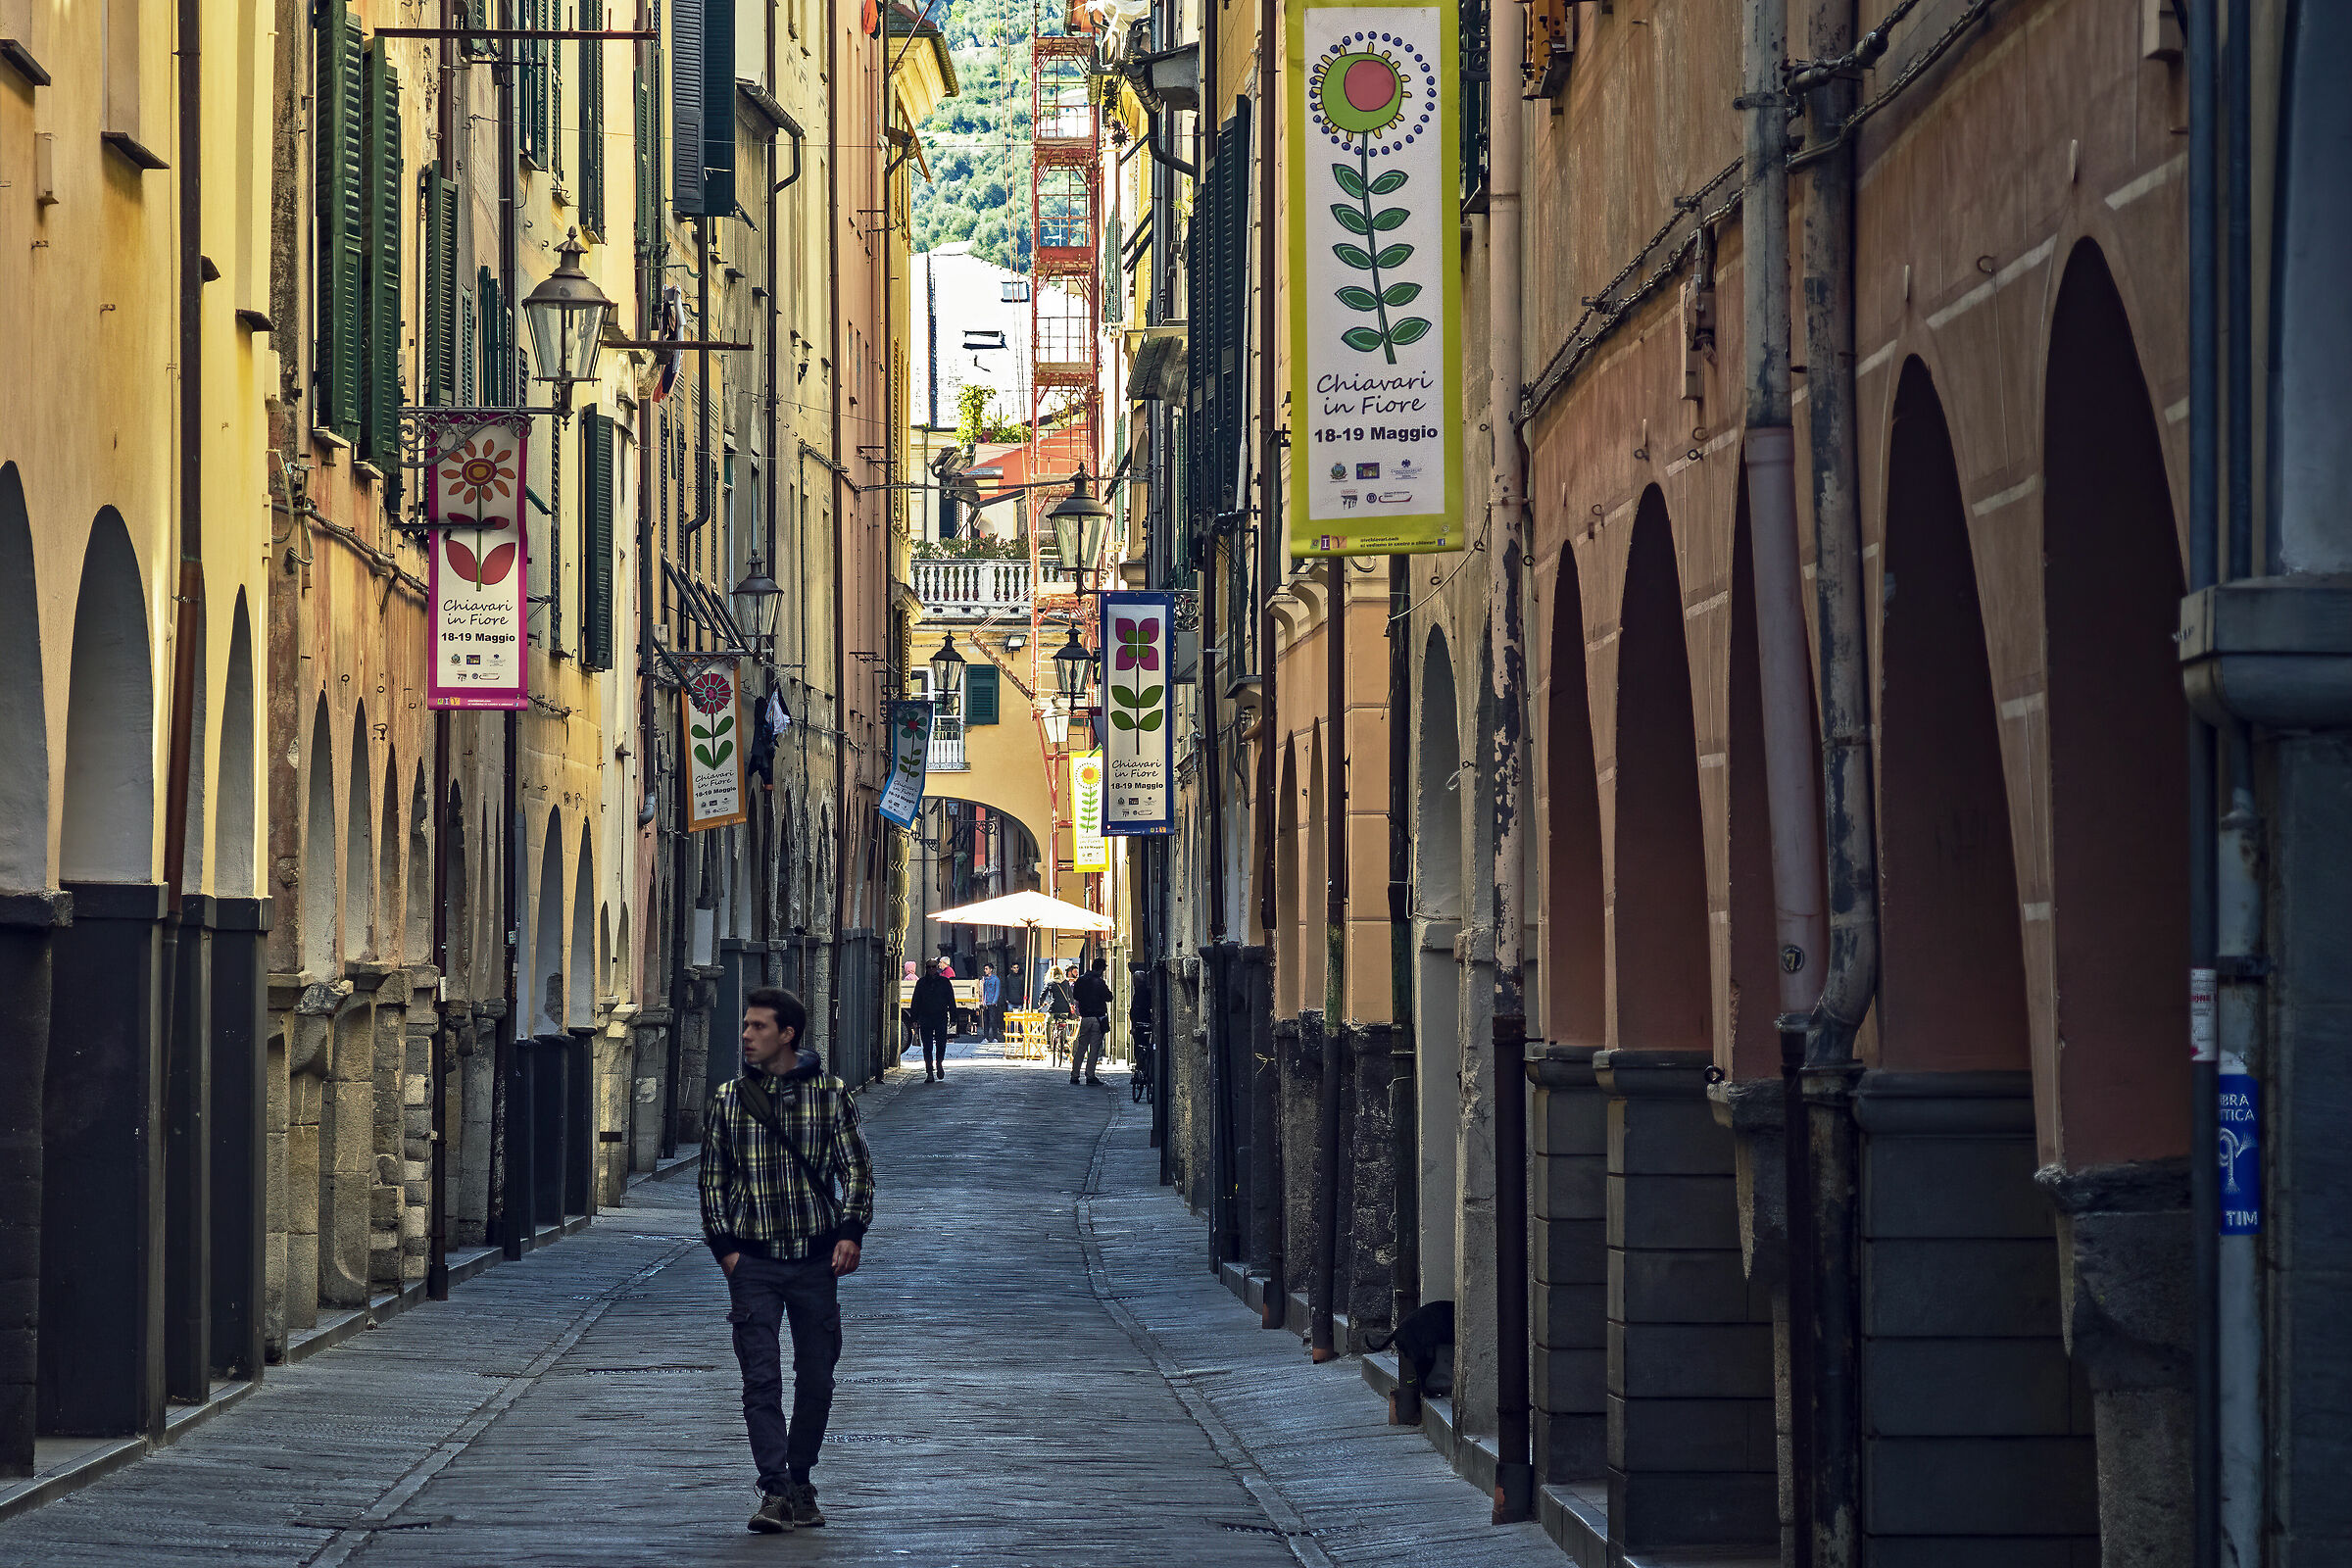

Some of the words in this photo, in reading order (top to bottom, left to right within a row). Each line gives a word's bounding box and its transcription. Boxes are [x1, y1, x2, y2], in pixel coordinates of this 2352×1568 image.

[1316, 370, 1434, 394] Chiavari
[1323, 396, 1355, 416] in
[1361, 395, 1427, 416] Fiore
[1314, 427, 1365, 443] 18-19
[1371, 425, 1439, 442] Maggio
[443, 600, 514, 612] Chiavari
[447, 612, 466, 625] in
[469, 612, 509, 625] Fiore
[441, 632, 472, 642] 18-19
[475, 632, 515, 644] Maggio
[1111, 760, 1161, 768] Chiavari
[696, 770, 734, 782] Chiavari
[2219, 1108, 2255, 1122] TTICA
[2226, 1210, 2258, 1226] TIM
